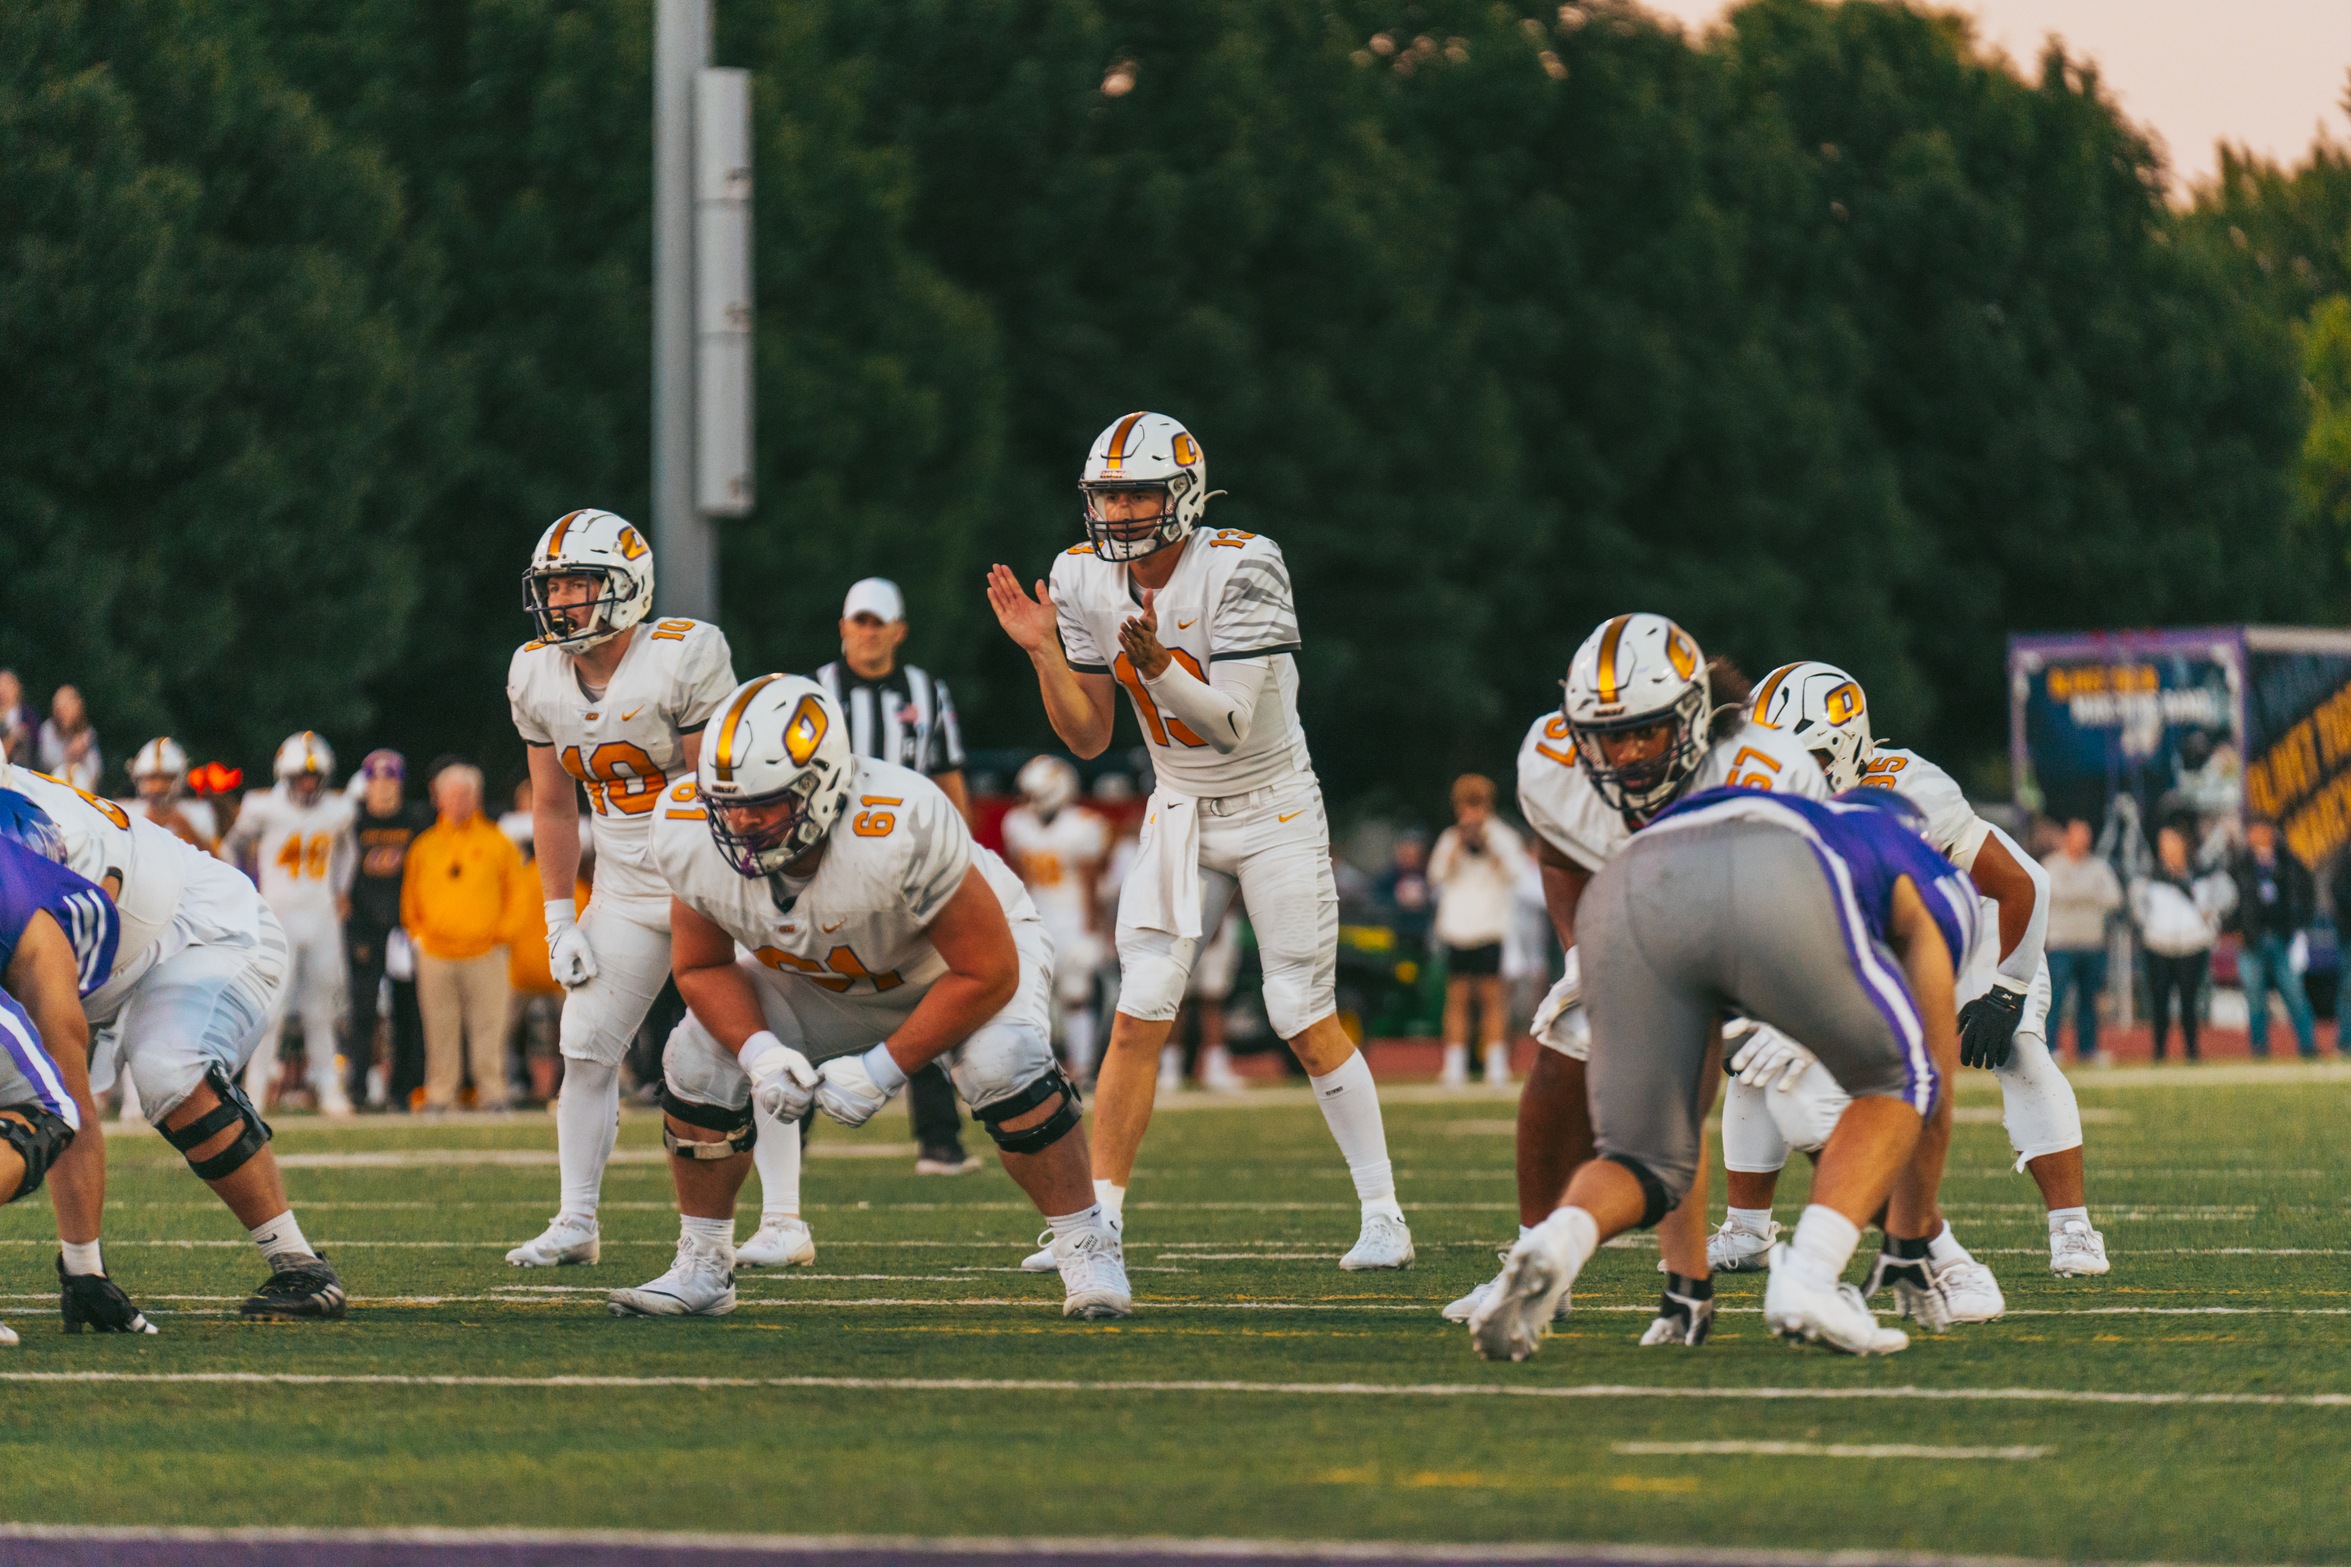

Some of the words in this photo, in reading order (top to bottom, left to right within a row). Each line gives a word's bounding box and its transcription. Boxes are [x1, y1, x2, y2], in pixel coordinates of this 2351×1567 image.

[651, 619, 696, 641] 10
[560, 740, 668, 816] 10
[1725, 745, 1783, 792] 57
[852, 794, 904, 837] 61
